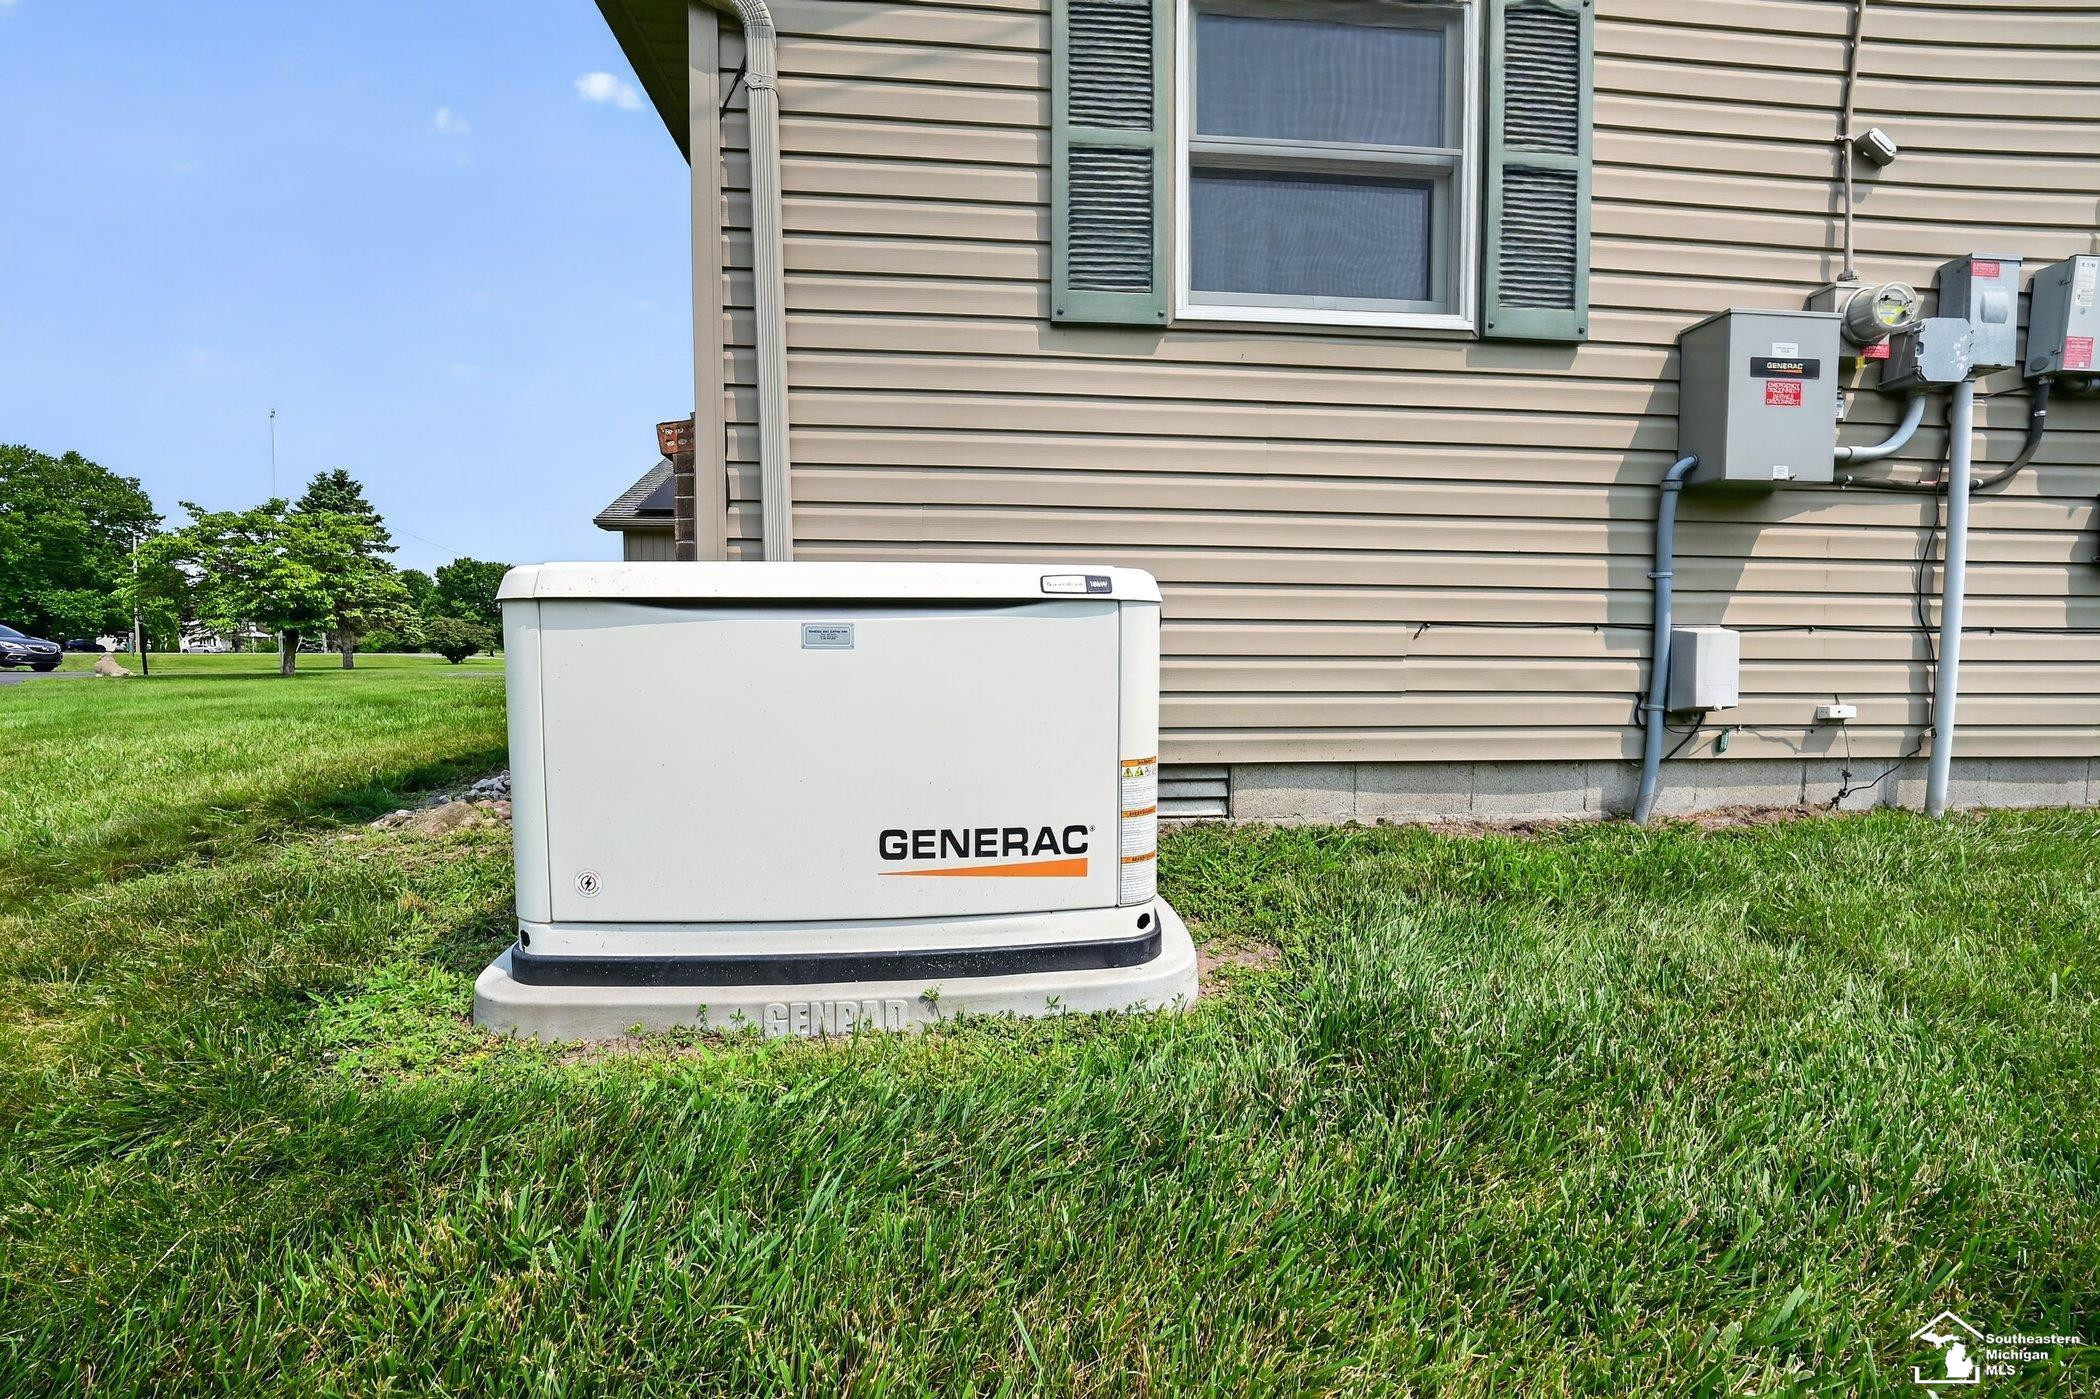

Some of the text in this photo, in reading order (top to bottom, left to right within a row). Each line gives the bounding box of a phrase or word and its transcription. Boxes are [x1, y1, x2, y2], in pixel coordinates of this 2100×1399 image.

[1766, 362, 1804, 370] GENERAC
[879, 825, 1089, 860] GENERAC
[762, 999, 909, 1038] GENPAD
